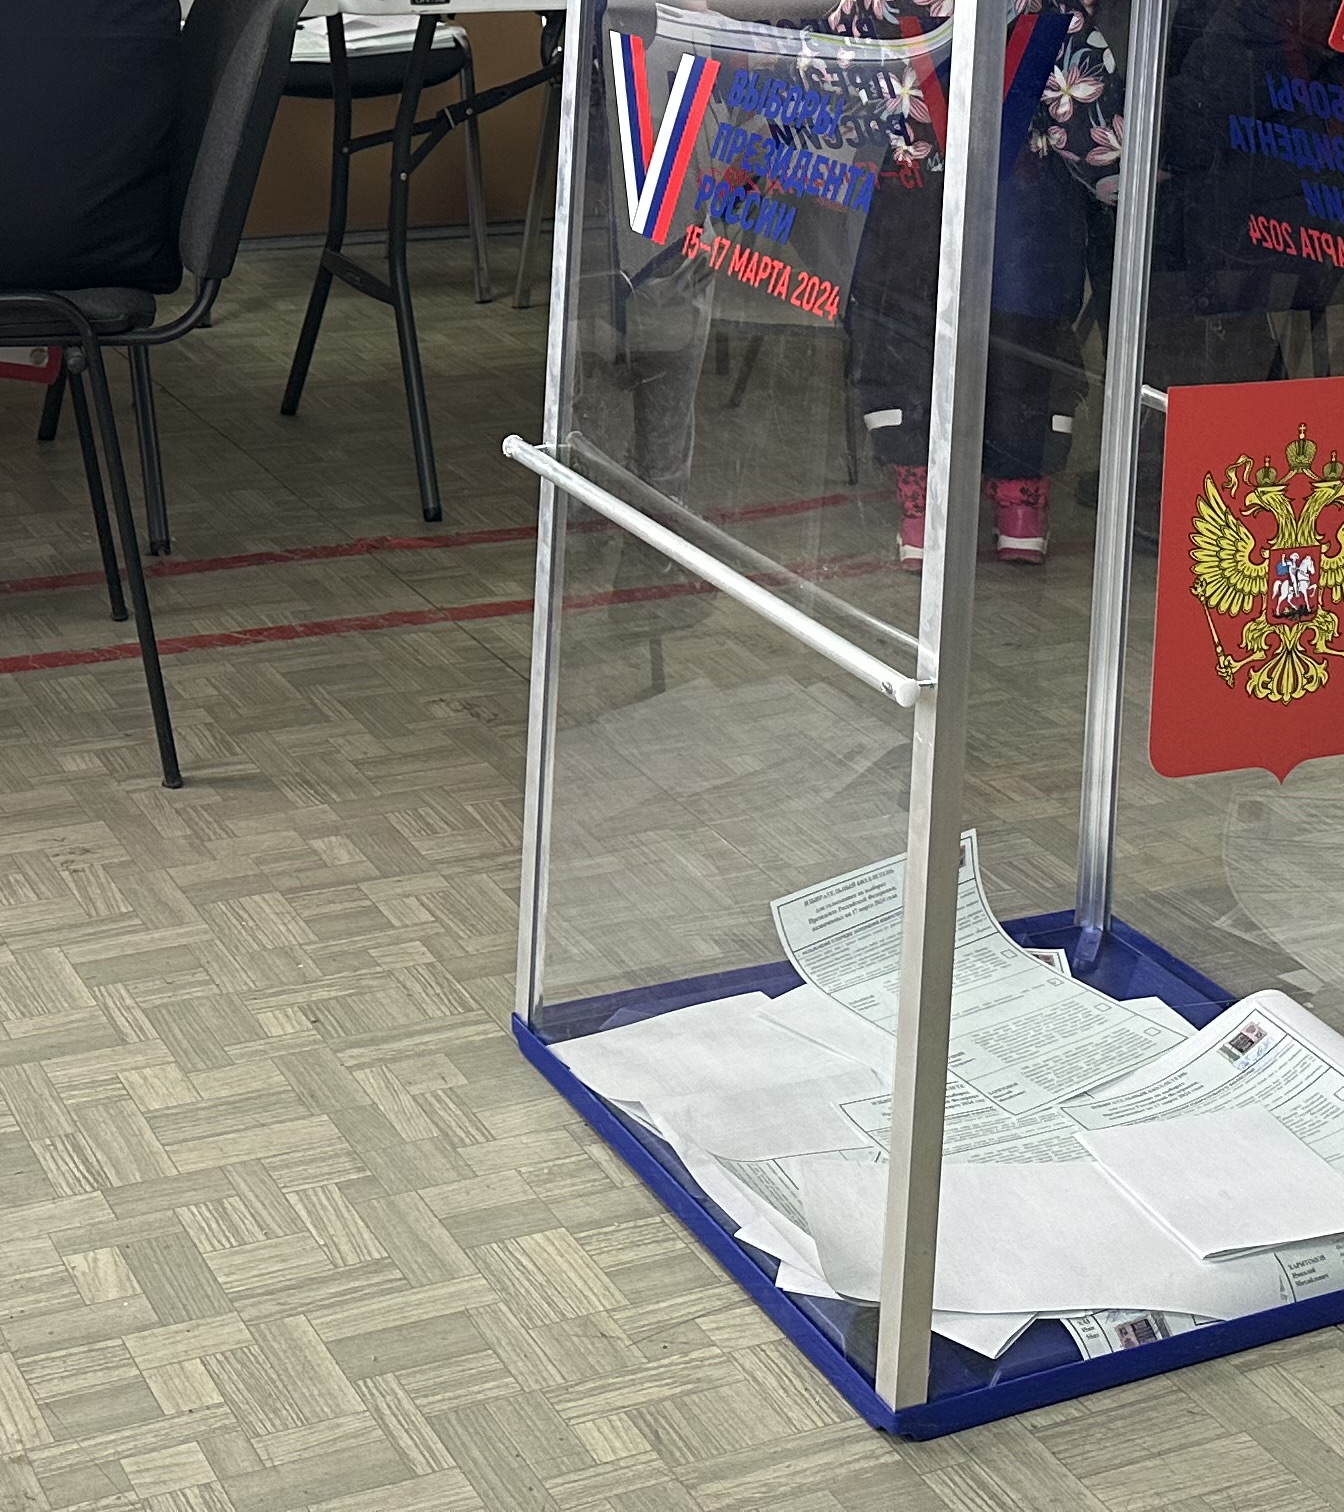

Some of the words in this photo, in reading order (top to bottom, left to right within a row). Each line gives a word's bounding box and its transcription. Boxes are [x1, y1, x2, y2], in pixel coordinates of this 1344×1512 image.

[729, 69, 845, 139] ВЫБОРЫ
[711, 122, 875, 213] ПРЕЗИДЕНТА
[694, 174, 796, 245] РОССИИ
[727, 252, 793, 299] МАРТА
[790, 271, 843, 320] 2024
